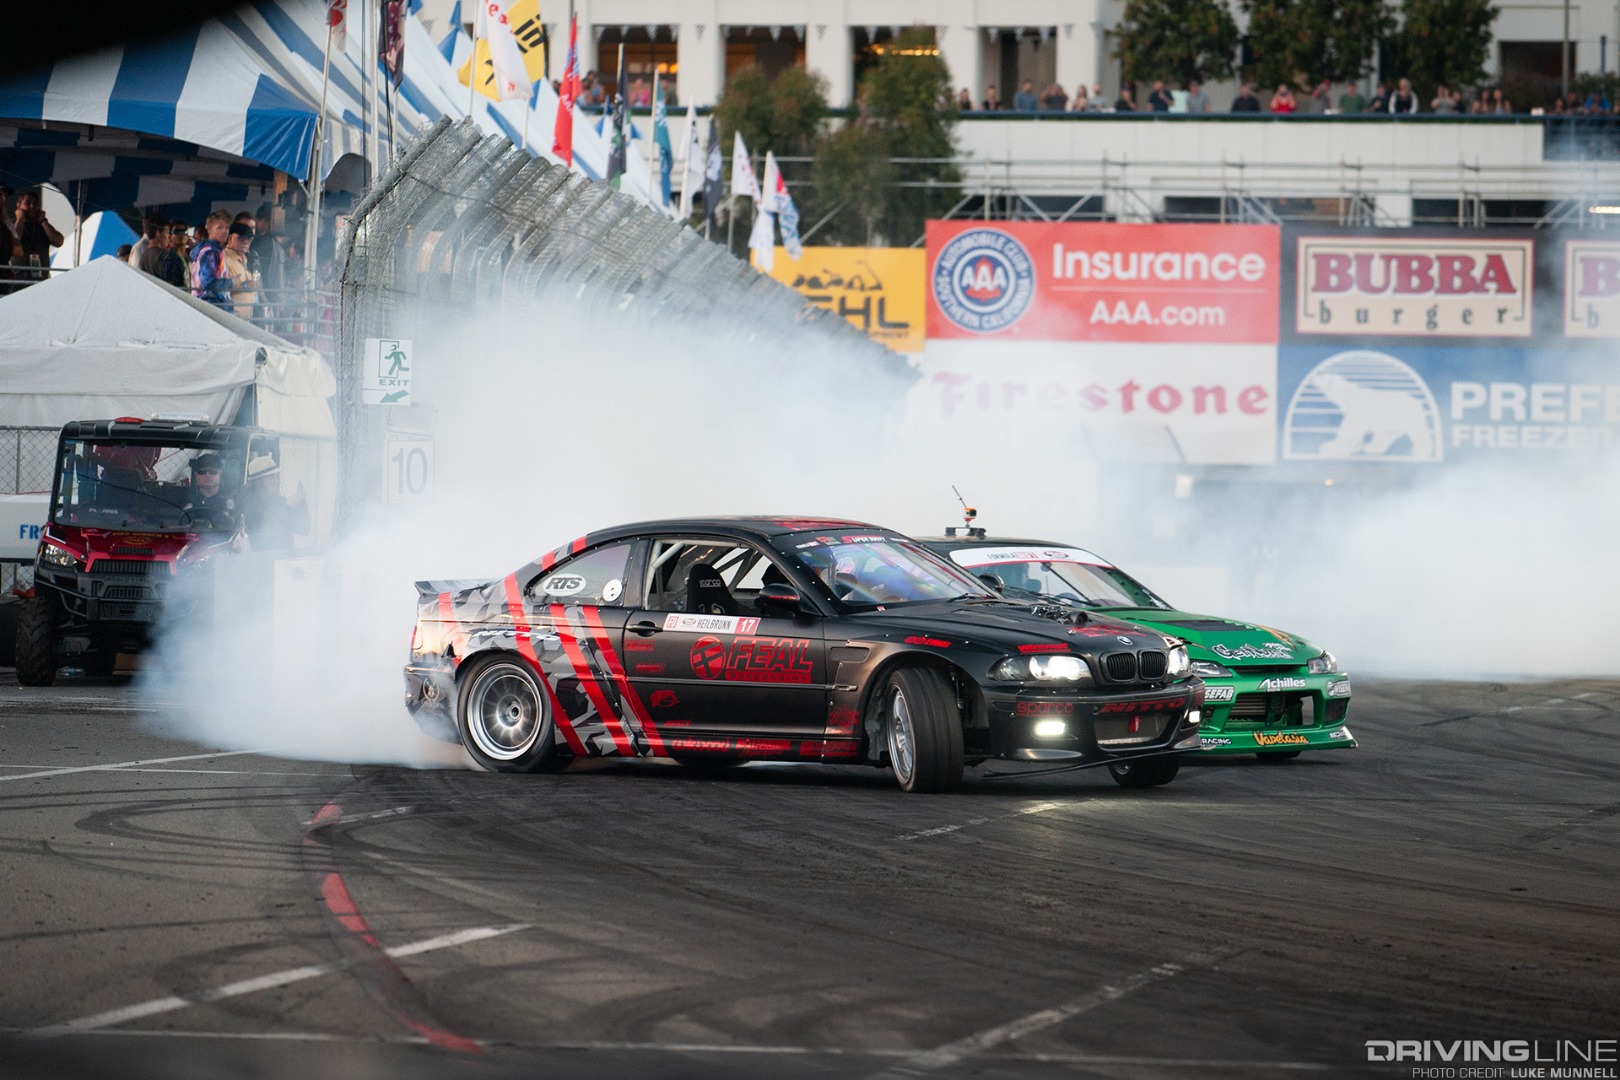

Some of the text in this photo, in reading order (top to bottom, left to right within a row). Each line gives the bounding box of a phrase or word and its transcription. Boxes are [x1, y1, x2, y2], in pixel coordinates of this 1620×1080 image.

[1052, 243, 1266, 281] Insurance
[1311, 253, 1517, 294] BUBBA
[961, 265, 1007, 291] AAA
[1089, 300, 1226, 326] AAA.com
[1319, 301, 1507, 330] burger
[379, 378, 410, 386] EXIT
[931, 371, 1270, 418] Firestone
[391, 447, 428, 496] 10
[545, 577, 583, 590] RTS
[696, 618, 732, 630] HEILBRUNN
[740, 619, 752, 632] 17
[726, 637, 813, 672] FEAL
[1259, 678, 1306, 688] Achilles
[1016, 702, 1073, 716] sparco
[1101, 698, 1185, 714] NITTO
